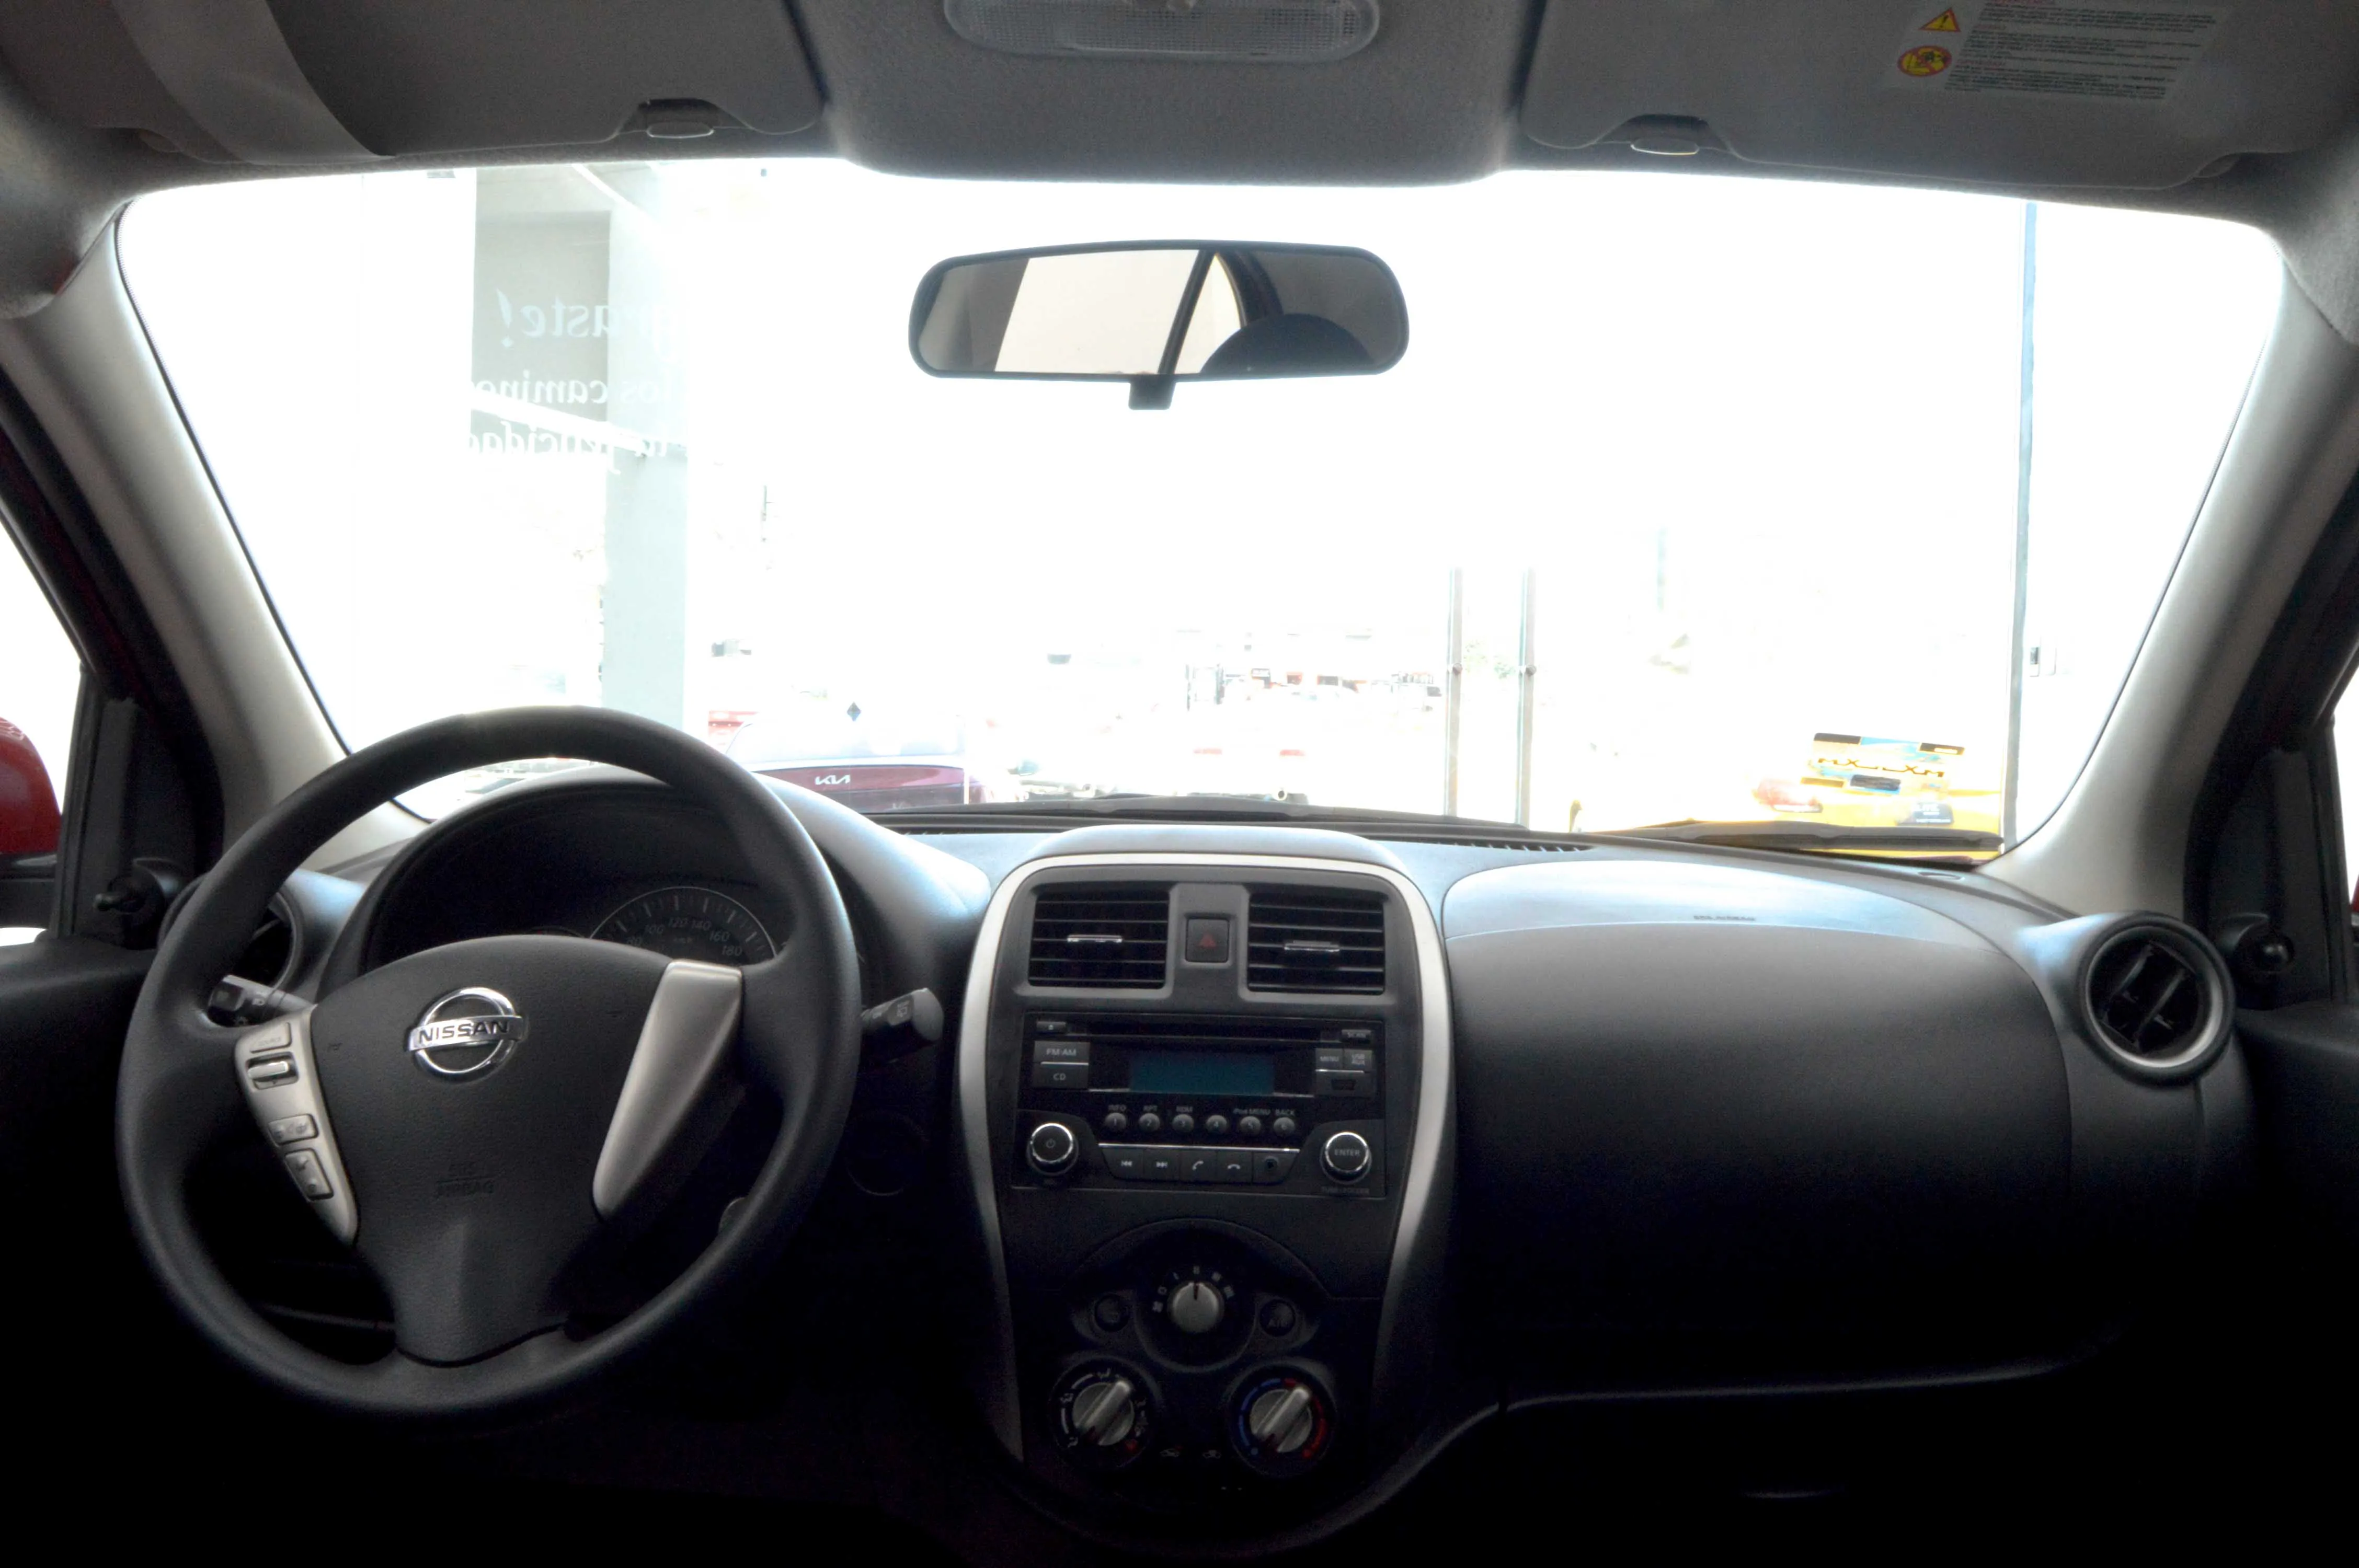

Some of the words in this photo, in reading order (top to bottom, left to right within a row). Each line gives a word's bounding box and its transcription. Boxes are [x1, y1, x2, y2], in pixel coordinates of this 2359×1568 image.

[668, 918, 689, 928] 120
[691, 920, 712, 931] 140
[709, 930, 730, 942] 160
[722, 945, 743, 957] 180
[418, 1021, 509, 1044] NISSAN
[1052, 1073, 1067, 1081] CD
